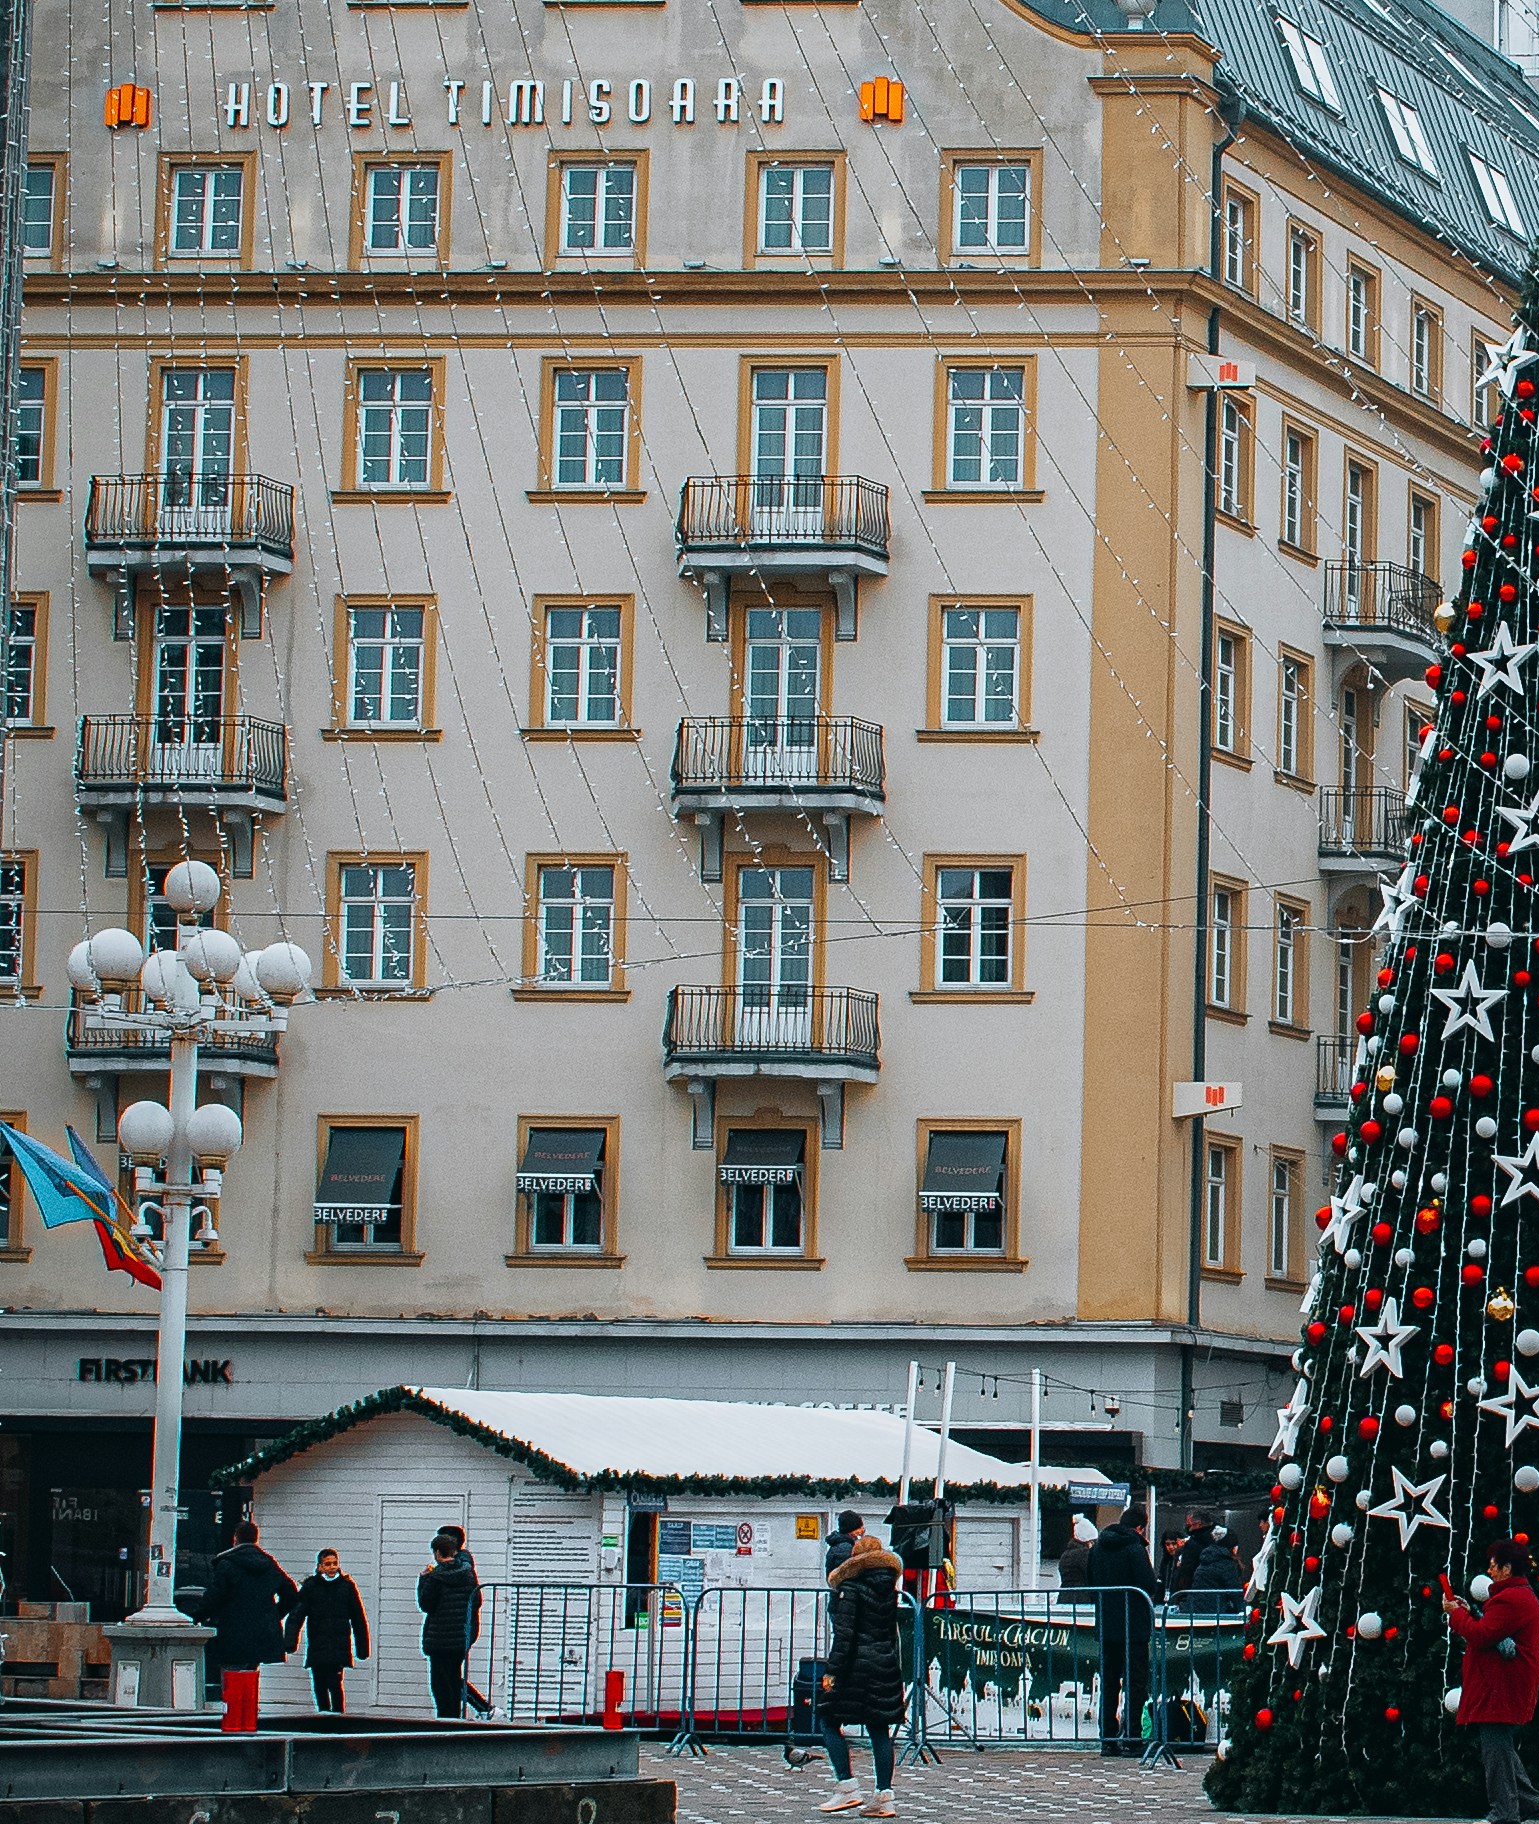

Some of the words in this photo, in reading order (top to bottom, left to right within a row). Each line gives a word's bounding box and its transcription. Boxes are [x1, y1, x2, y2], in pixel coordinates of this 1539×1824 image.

[223, 81, 410, 126] HOTEL
[443, 78, 784, 124] TIMISOARA
[720, 1169, 794, 1181] BELVEDERE
[517, 1177, 592, 1191] BELVEDERE
[921, 1197, 996, 1209] BELVEDERE
[315, 1208, 388, 1221] BELVEDERE
